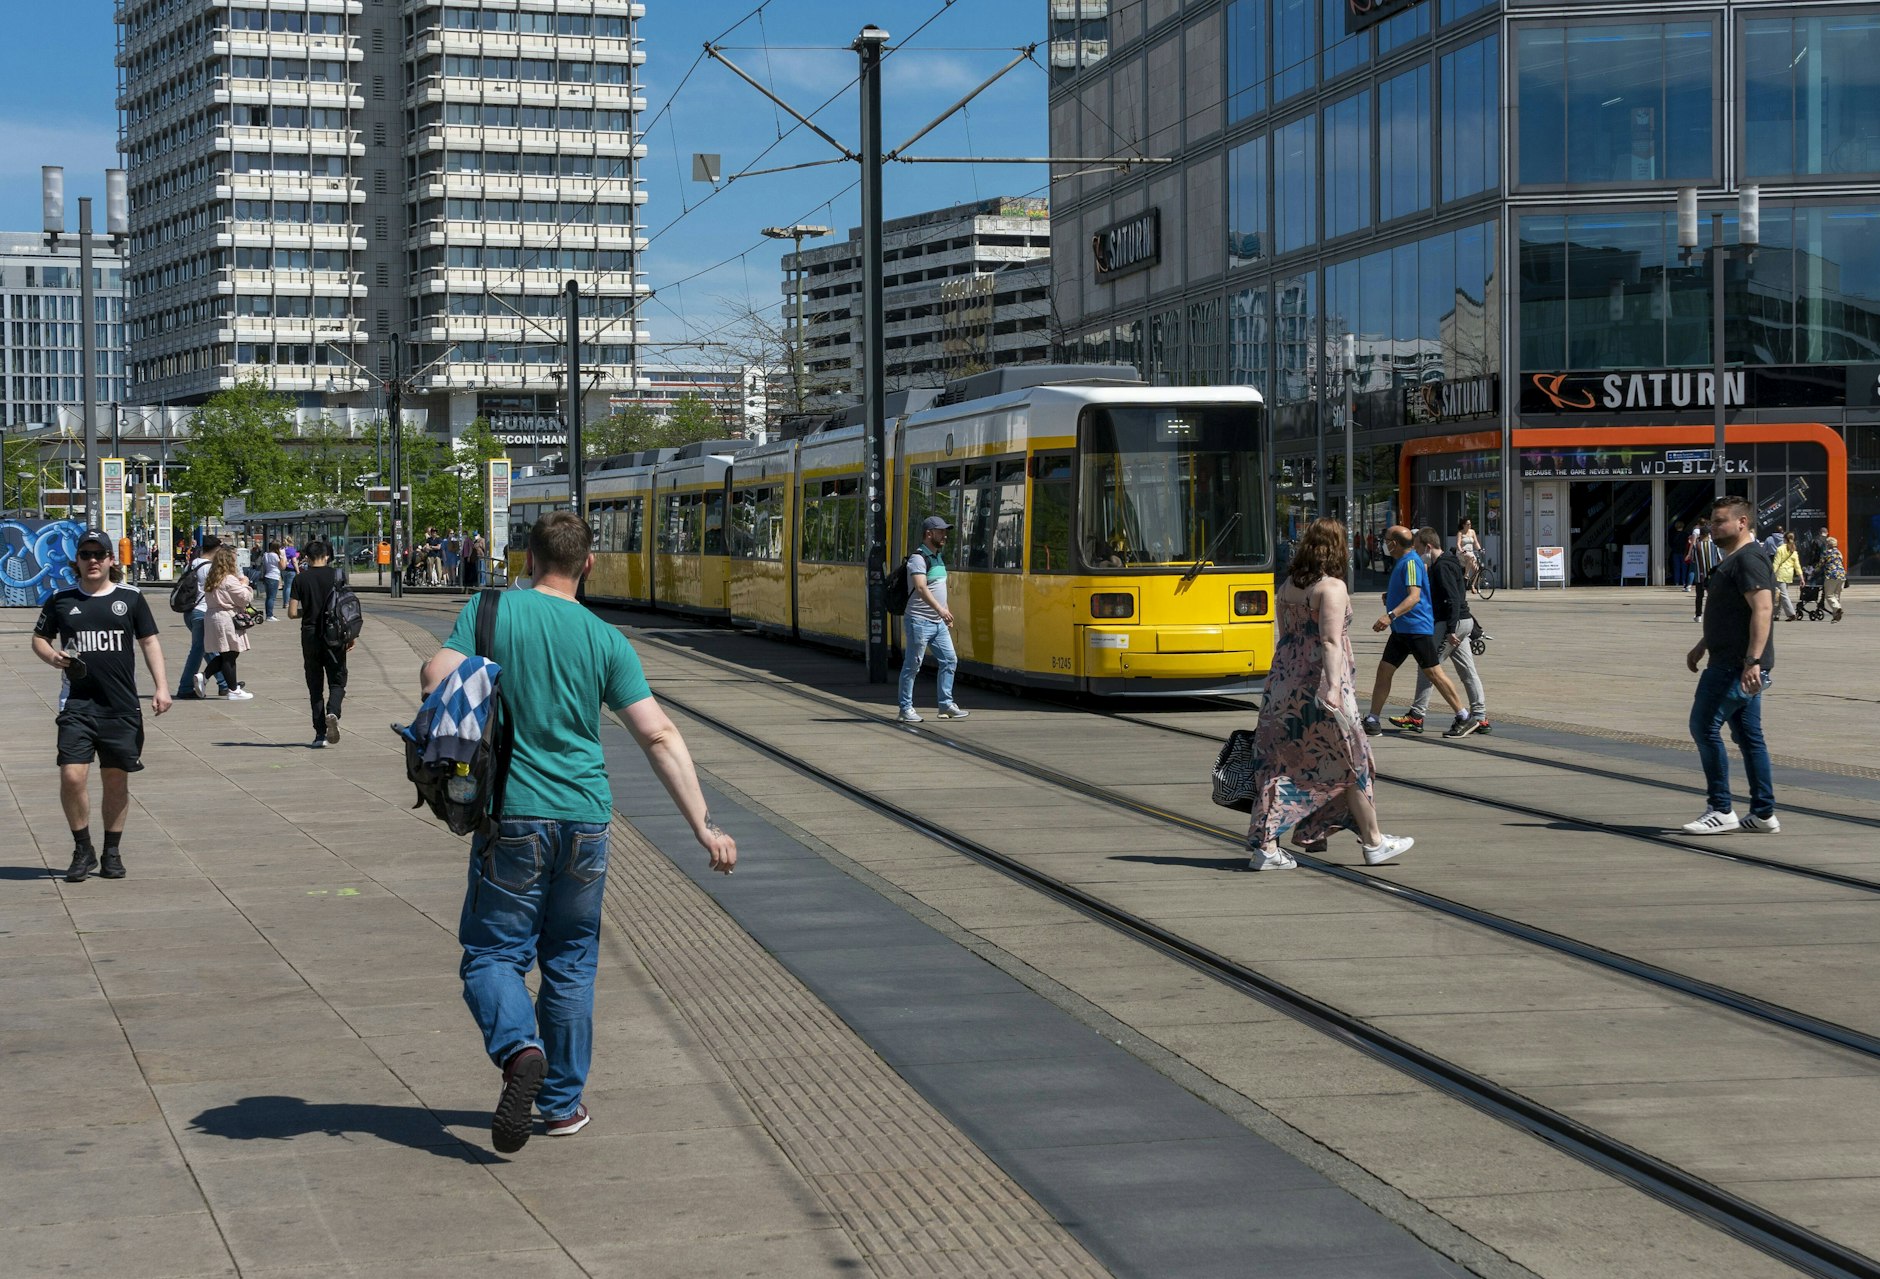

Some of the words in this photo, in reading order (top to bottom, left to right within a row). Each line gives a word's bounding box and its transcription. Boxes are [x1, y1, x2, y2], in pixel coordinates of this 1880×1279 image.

[1110, 216, 1150, 270] SATURN
[1442, 379, 1488, 417] SATURN
[1603, 371, 1746, 409] SATURN
[490, 415, 564, 431] HUMAN
[492, 435, 567, 445] SECOND-HAN
[1052, 656, 1071, 670] B-1245
